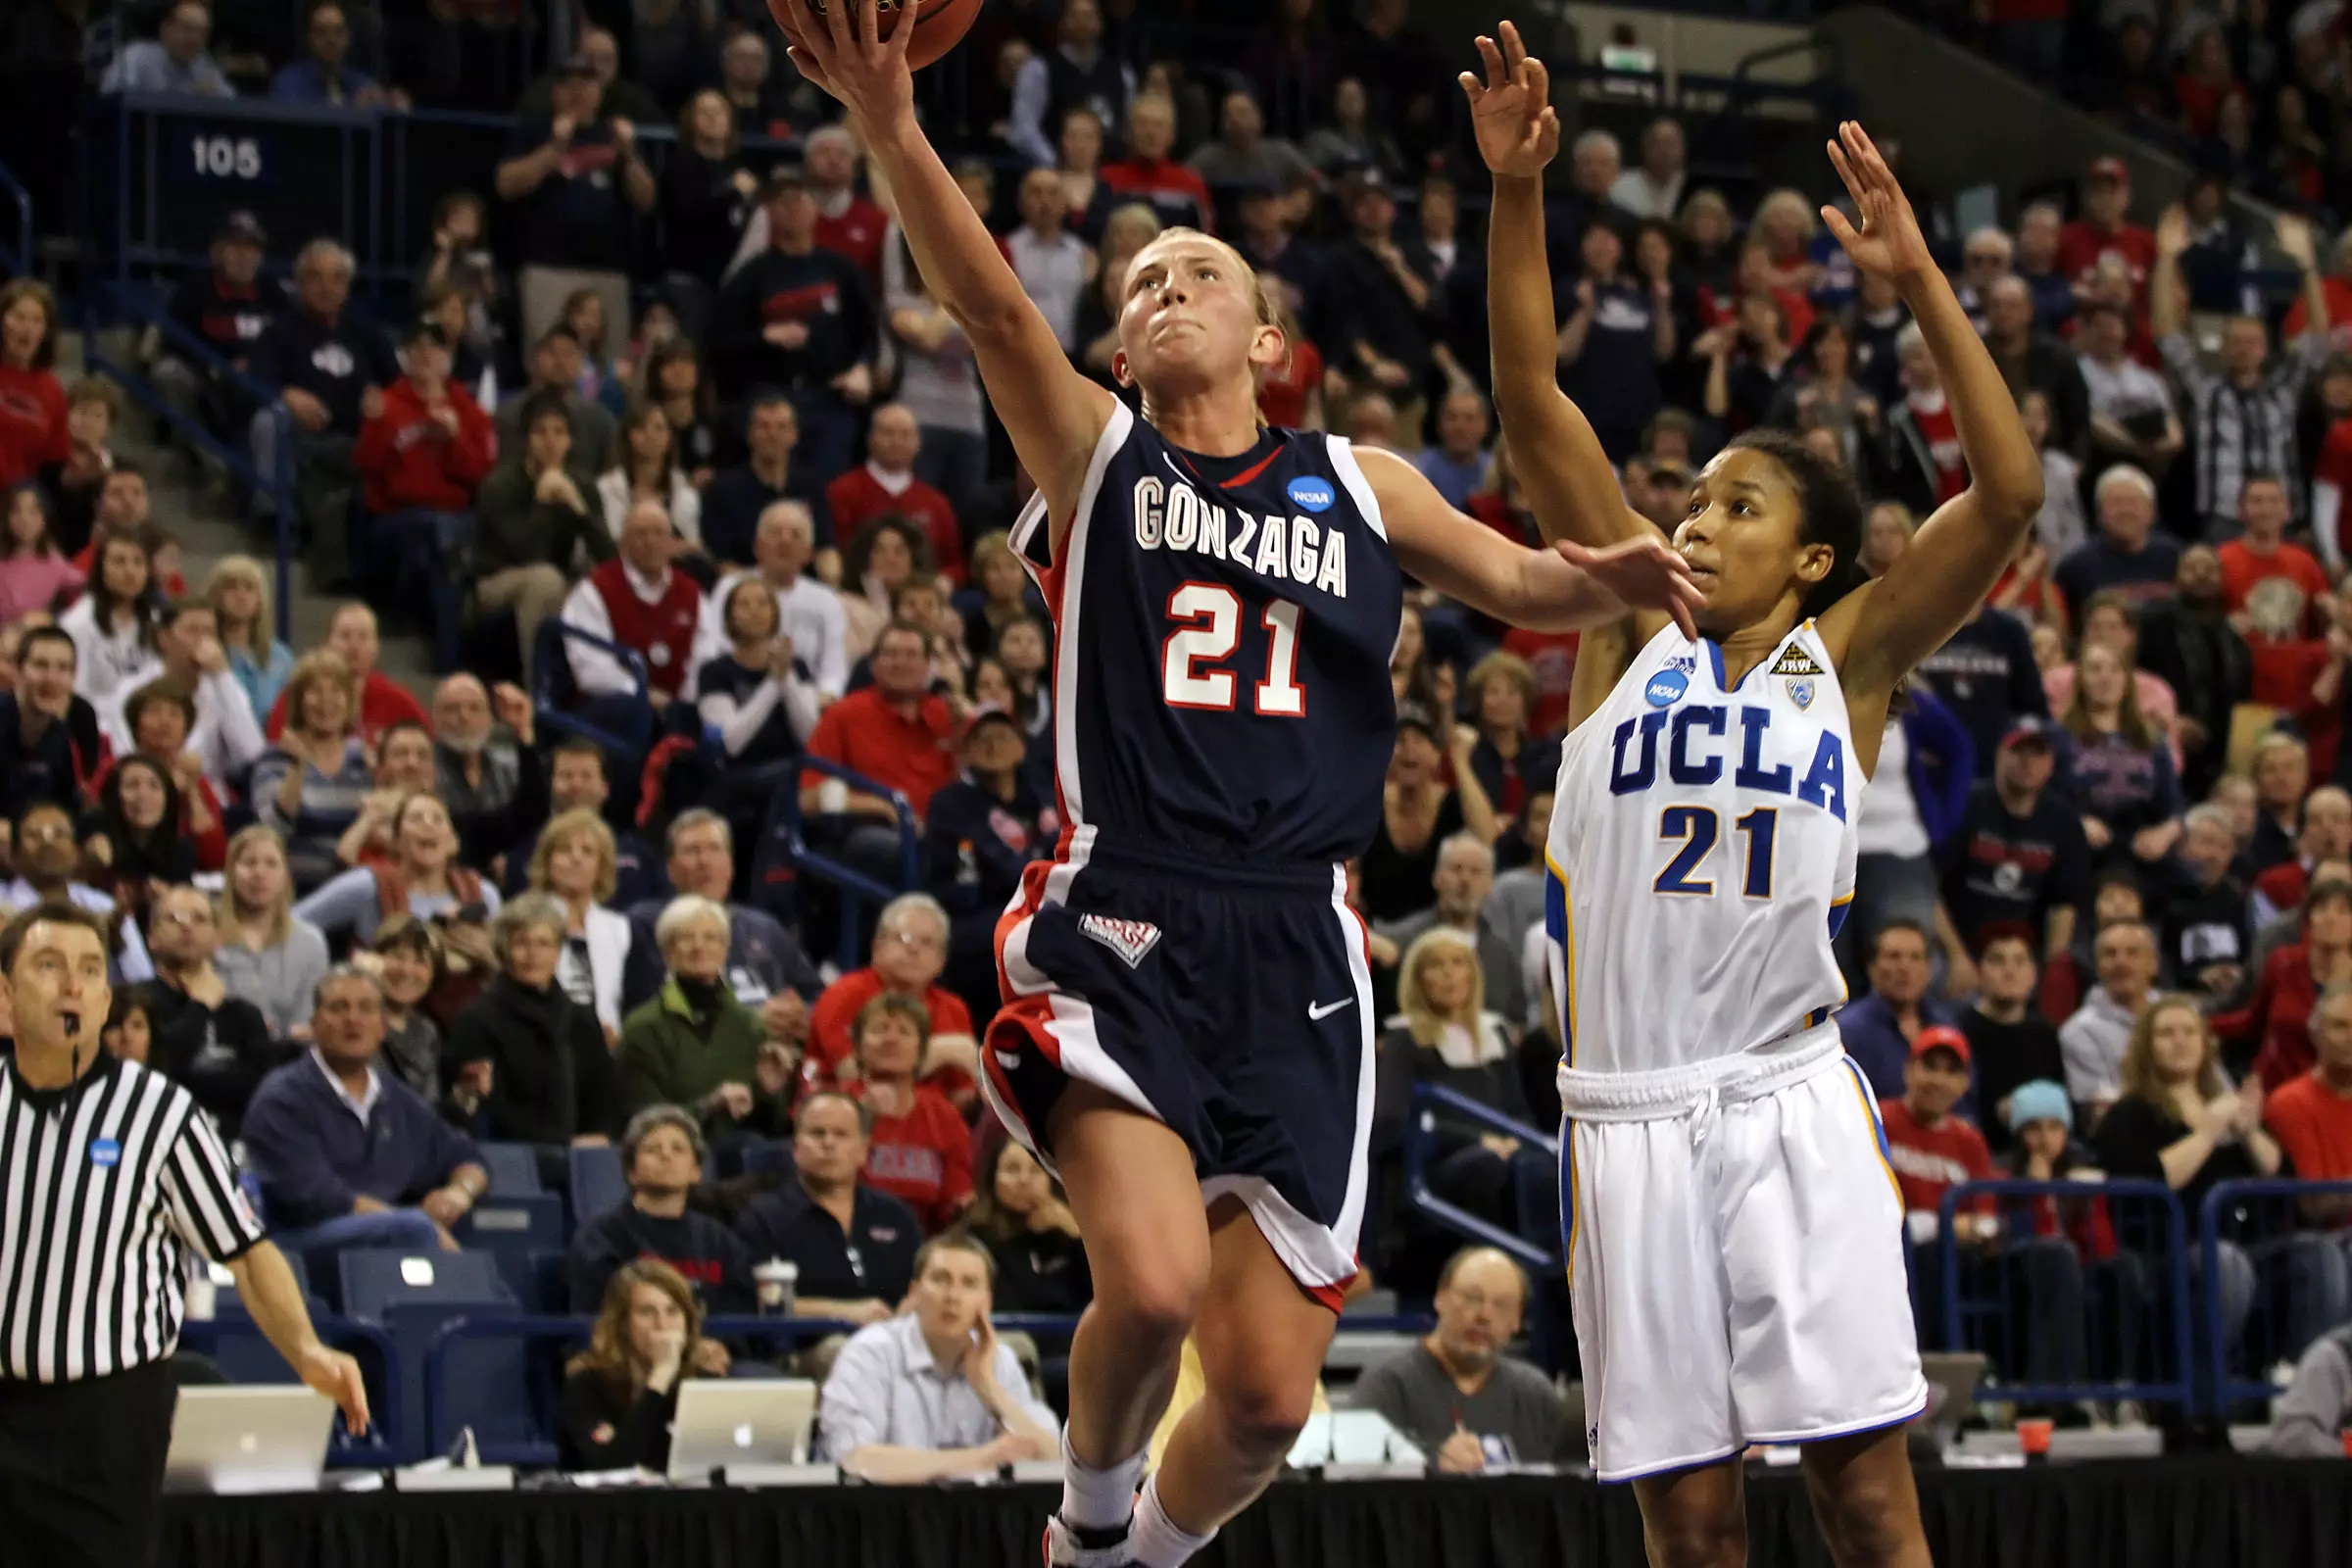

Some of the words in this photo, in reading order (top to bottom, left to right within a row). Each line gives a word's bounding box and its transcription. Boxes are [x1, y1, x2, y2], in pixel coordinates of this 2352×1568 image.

[191, 135, 262, 179] 105
[1133, 474, 1348, 599] GONZAGA
[1294, 490, 1330, 505] NCAA
[1161, 579, 1307, 718] 21
[1649, 685, 1682, 700] NCAA
[1609, 705, 1846, 826] UCLA
[1653, 806, 1779, 897] 21
